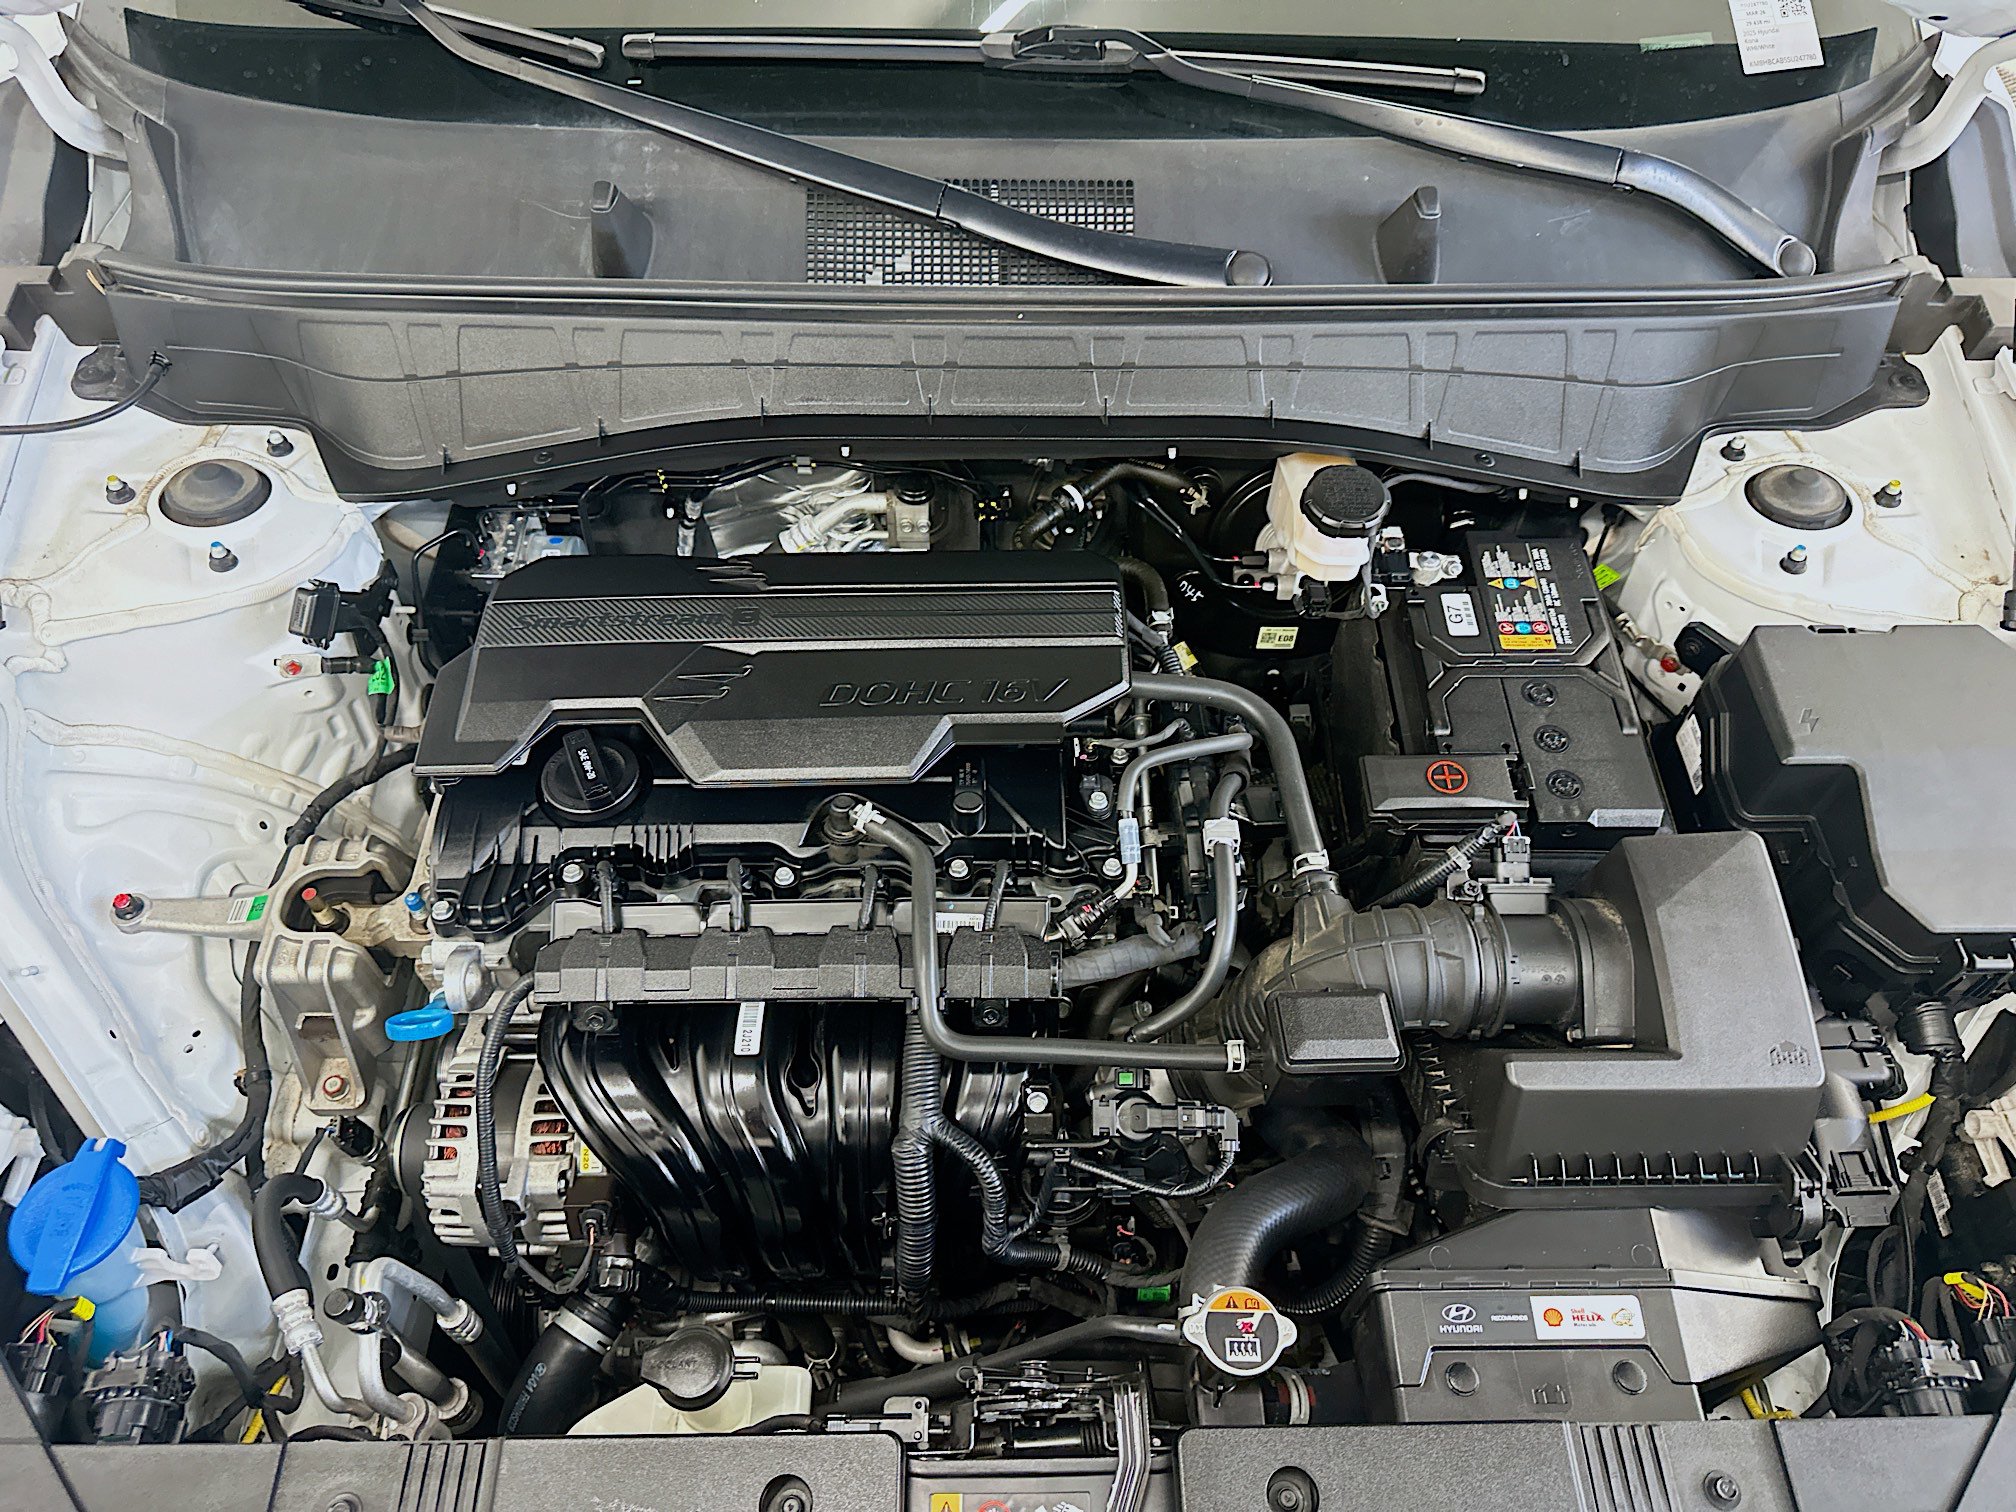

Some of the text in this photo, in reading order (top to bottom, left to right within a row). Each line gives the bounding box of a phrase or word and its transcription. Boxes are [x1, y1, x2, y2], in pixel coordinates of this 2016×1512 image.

[510, 610, 723, 631] Smartstream
[1447, 605, 1464, 624] G7
[819, 677, 1069, 707] DOHC 16V
[578, 748, 597, 780] SAE 0W-20
[740, 1029, 753, 1053] 2J210
[1571, 1313, 1605, 1322] HELIX
[1439, 1324, 1484, 1334] HYUNDAI
